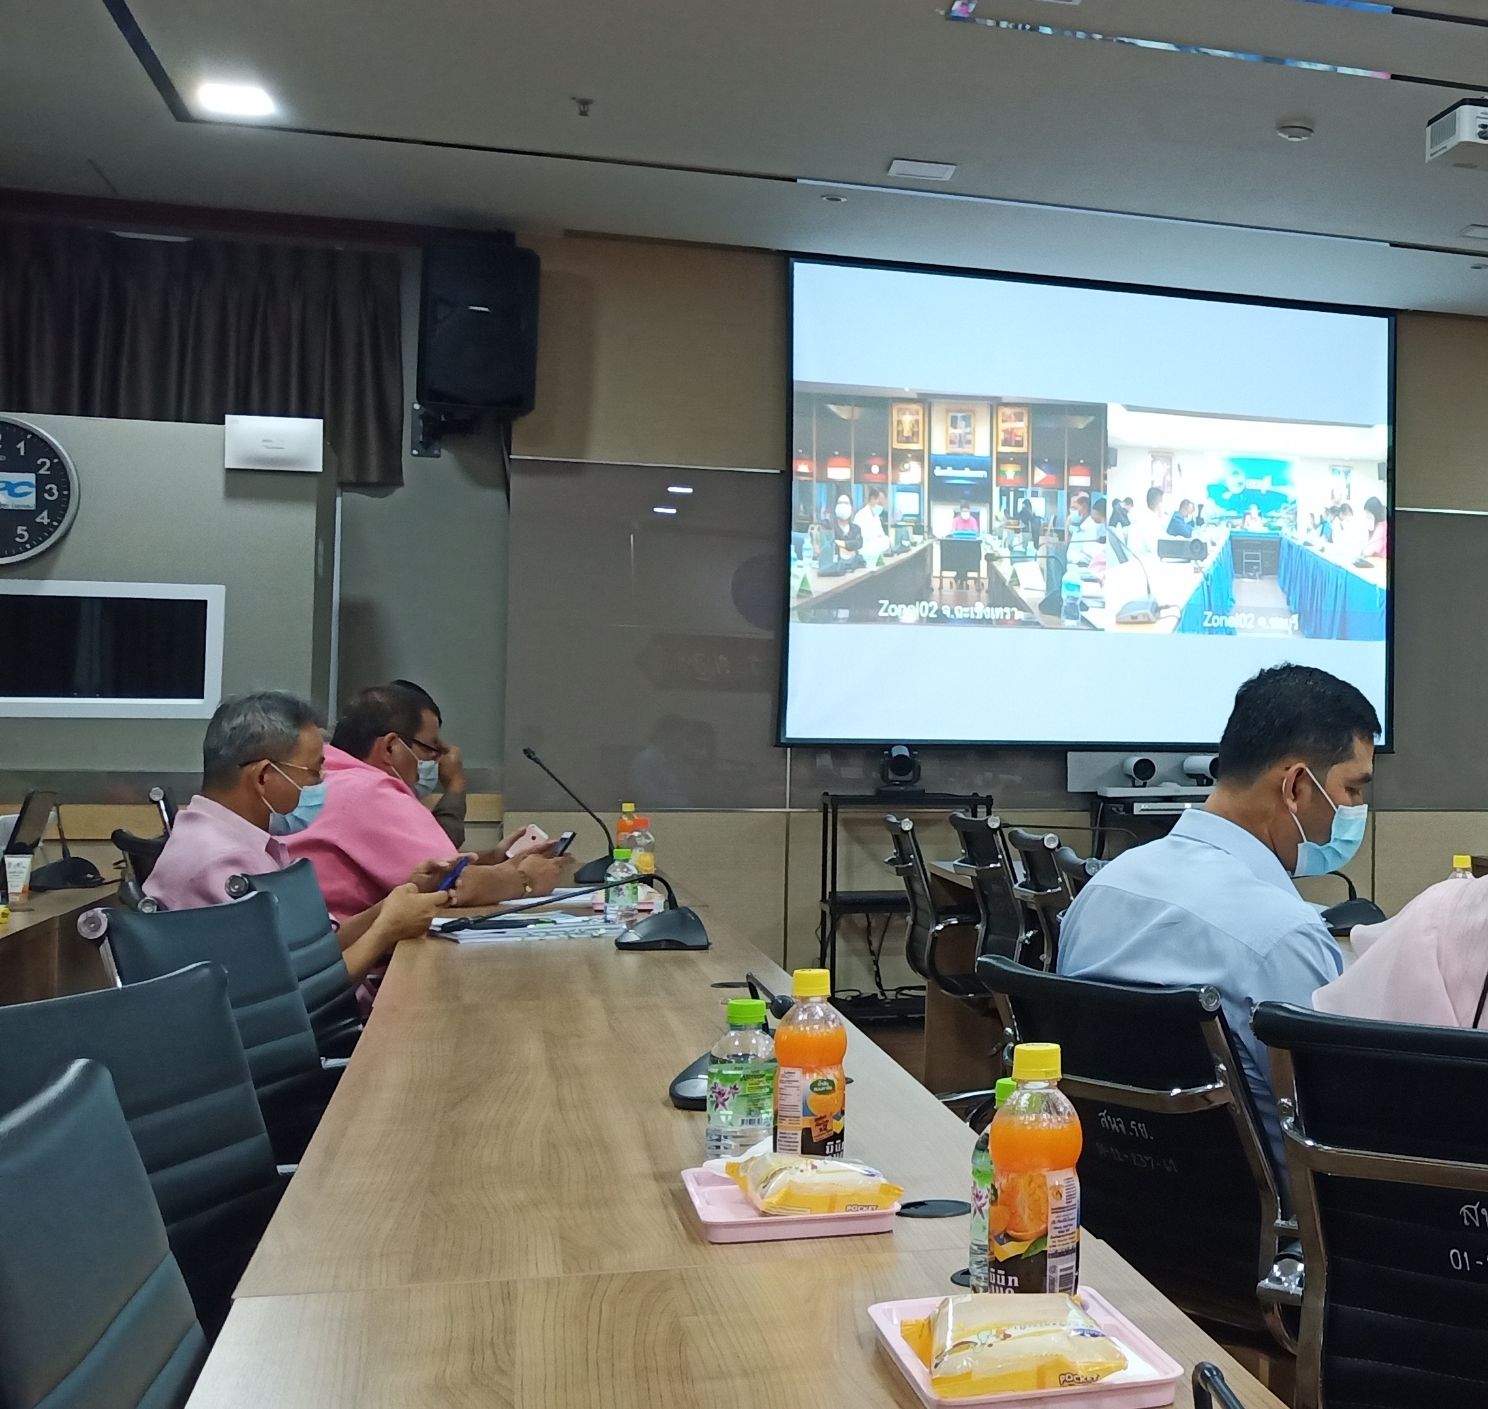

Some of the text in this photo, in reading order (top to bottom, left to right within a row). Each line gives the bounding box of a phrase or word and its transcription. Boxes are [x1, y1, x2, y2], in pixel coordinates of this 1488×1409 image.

[16, 440, 25, 456] 1
[36, 458, 51, 475] 2
[43, 484, 59, 500] 3
[35, 509, 51, 525] 4
[15, 526, 29, 543] 5
